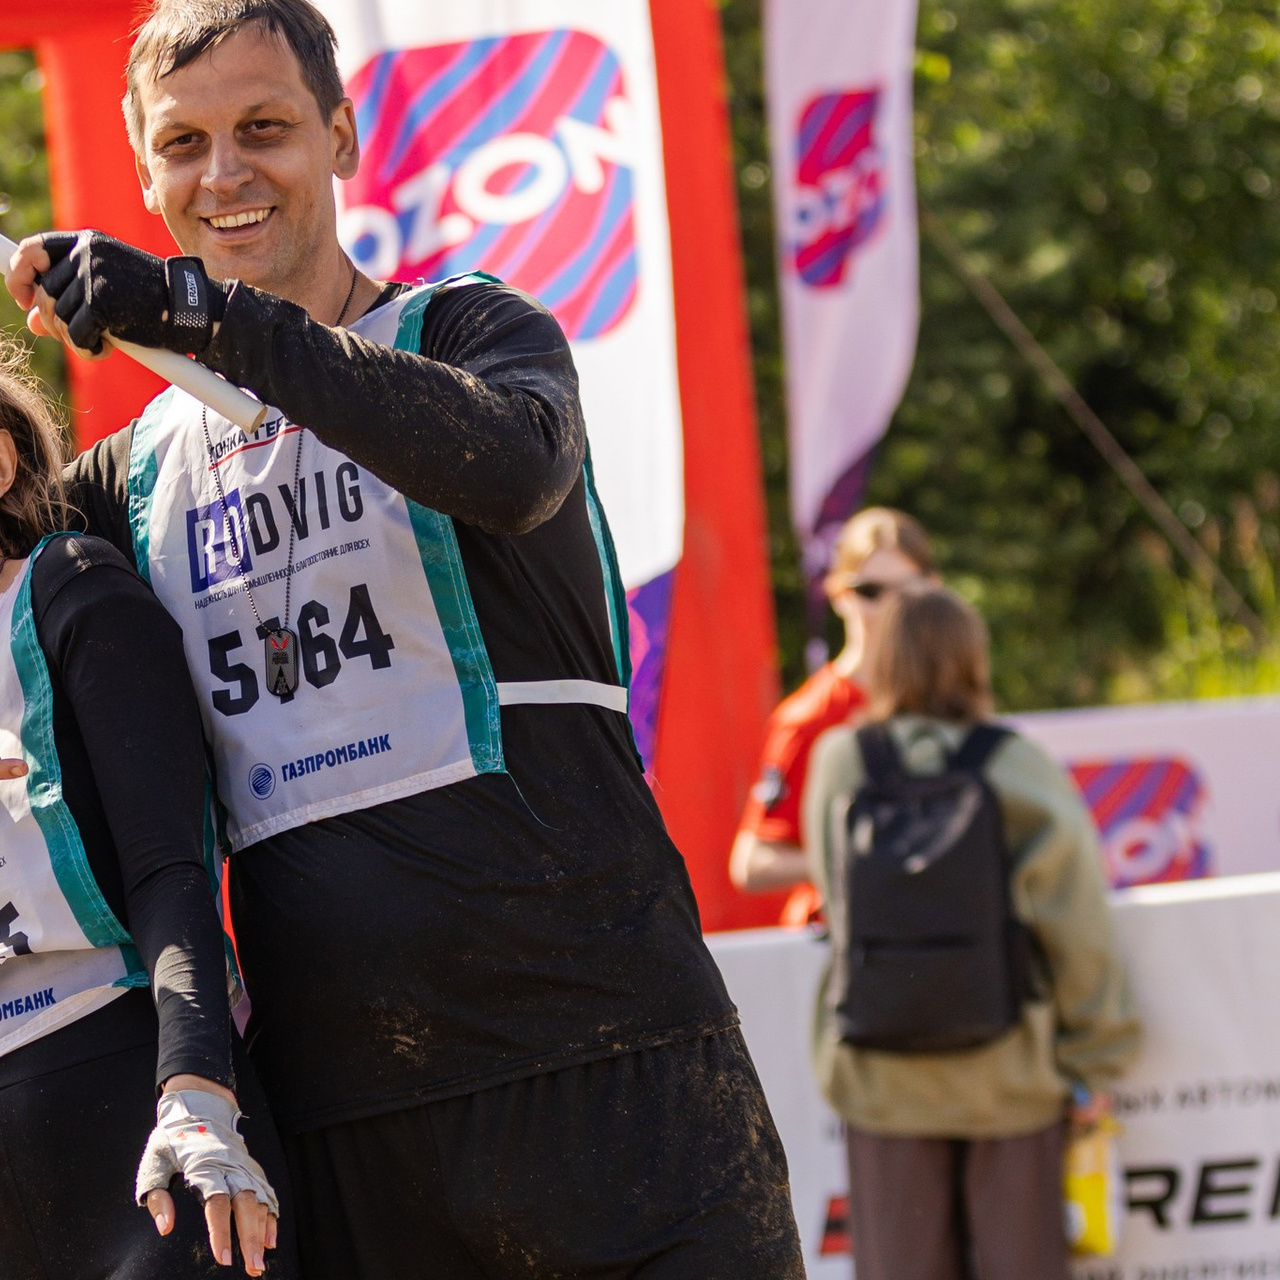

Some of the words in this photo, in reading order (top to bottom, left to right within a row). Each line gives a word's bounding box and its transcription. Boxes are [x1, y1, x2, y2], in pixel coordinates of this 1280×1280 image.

[253, 416, 295, 441] ГЕР
[191, 461, 364, 582] RODVIG
[353, 538, 371, 551] ВСЕХ
[281, 733, 392, 782] ГАЗПРОМБАНК
[1122, 1158, 1280, 1230] RE
